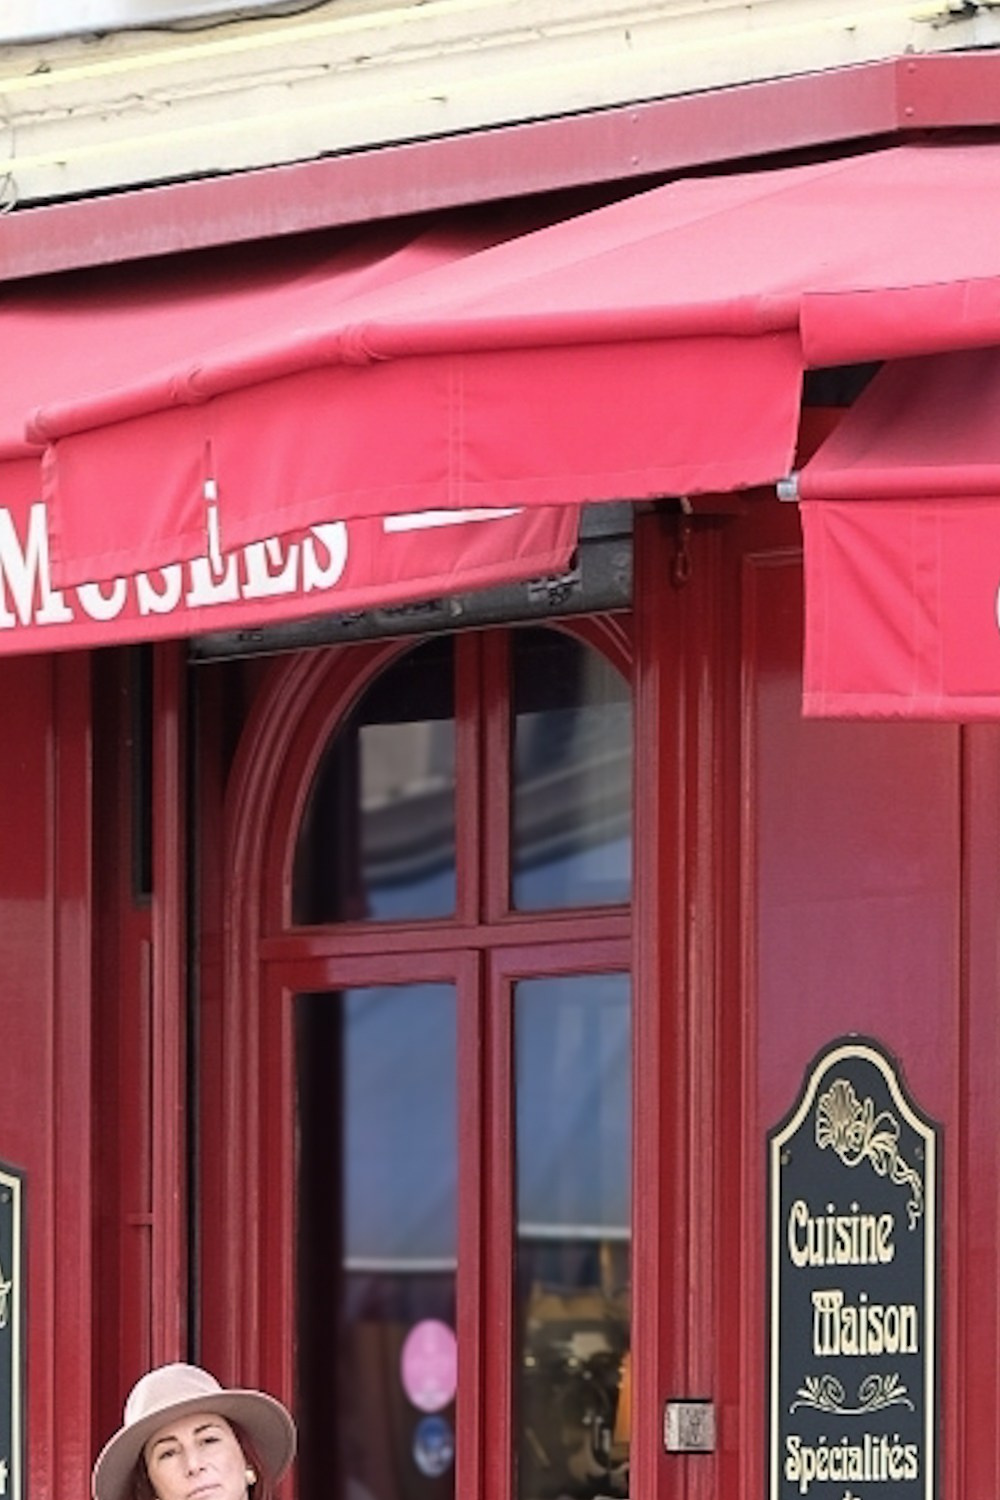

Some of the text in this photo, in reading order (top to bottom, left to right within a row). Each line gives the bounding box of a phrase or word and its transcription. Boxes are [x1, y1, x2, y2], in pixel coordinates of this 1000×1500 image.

[788, 1200, 895, 1268] Cuisine
[811, 1290, 918, 1356] Maison
[785, 1433, 918, 1495] Spécialités
